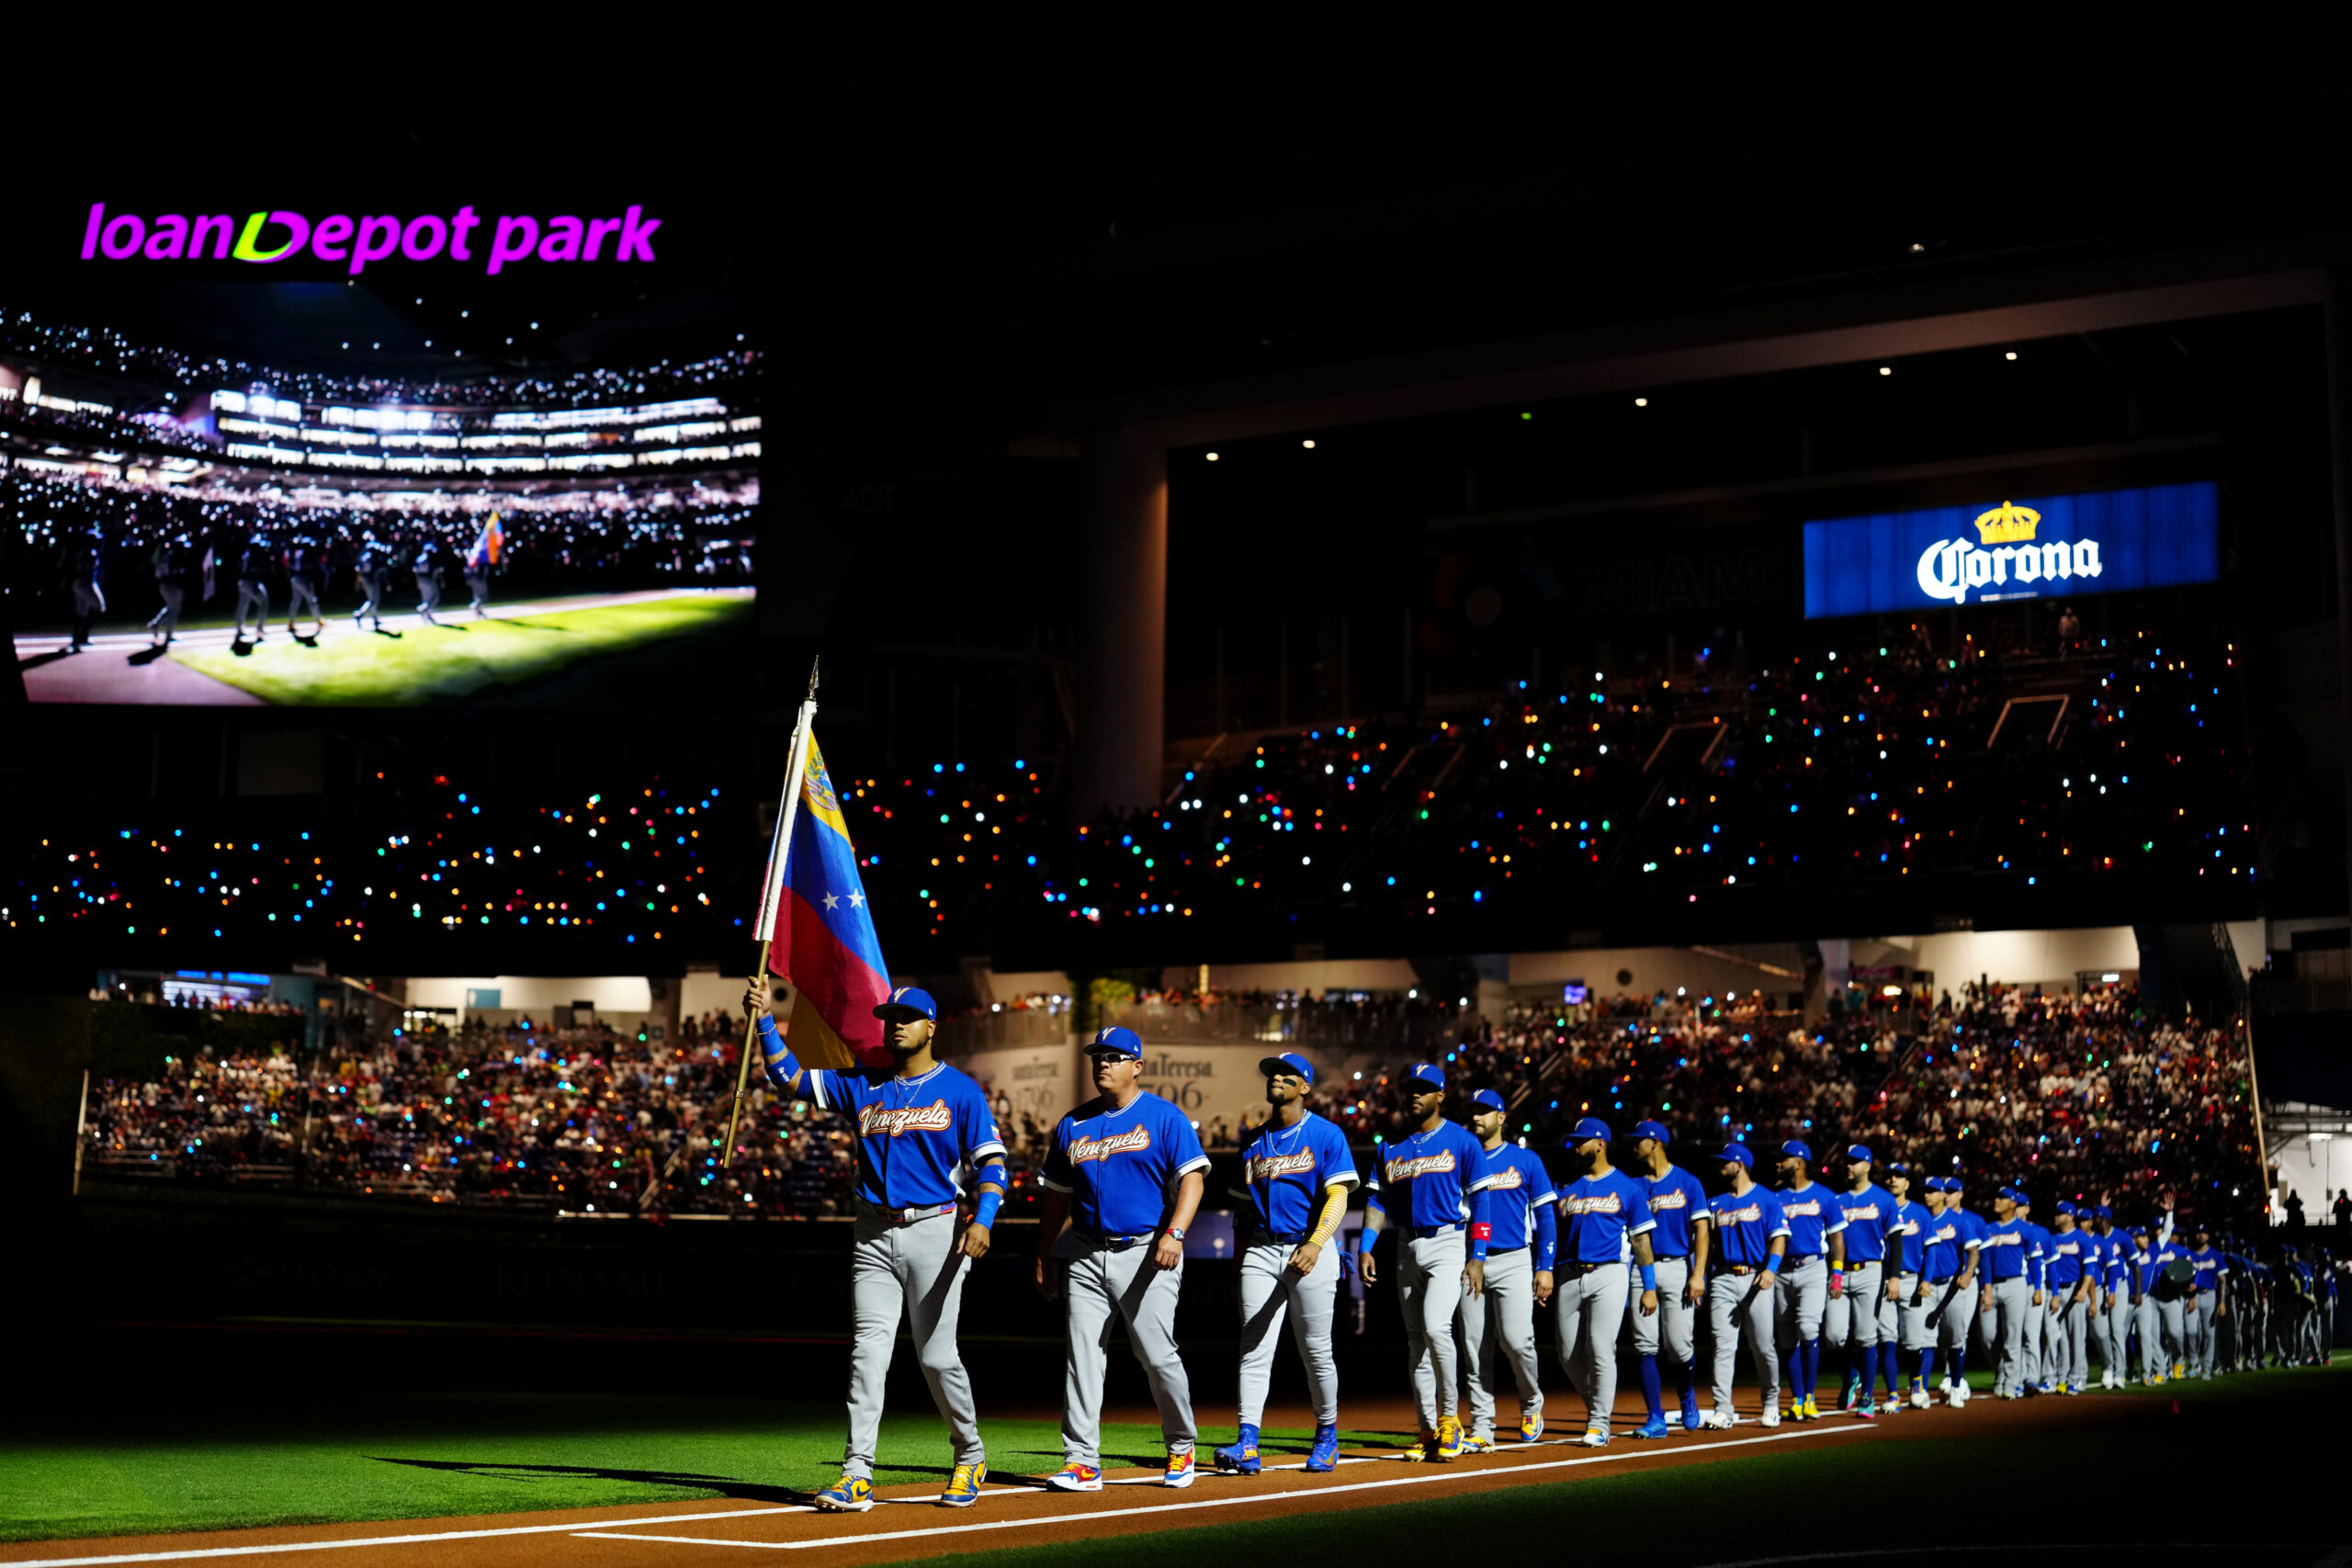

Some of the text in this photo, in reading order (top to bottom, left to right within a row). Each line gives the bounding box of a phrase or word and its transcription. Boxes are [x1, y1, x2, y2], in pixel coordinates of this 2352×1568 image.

[81, 202, 663, 275] loanDepot park
[1573, 546, 1786, 617] MIAMI
[1917, 536, 2103, 604] Corona
[859, 1099, 951, 1136] Venezuela
[1068, 1124, 1150, 1167] Venezuela
[1245, 1145, 1316, 1185] Venezuela
[1385, 1148, 1455, 1183] Venezuela
[1559, 1191, 1621, 1217] Venezuela
